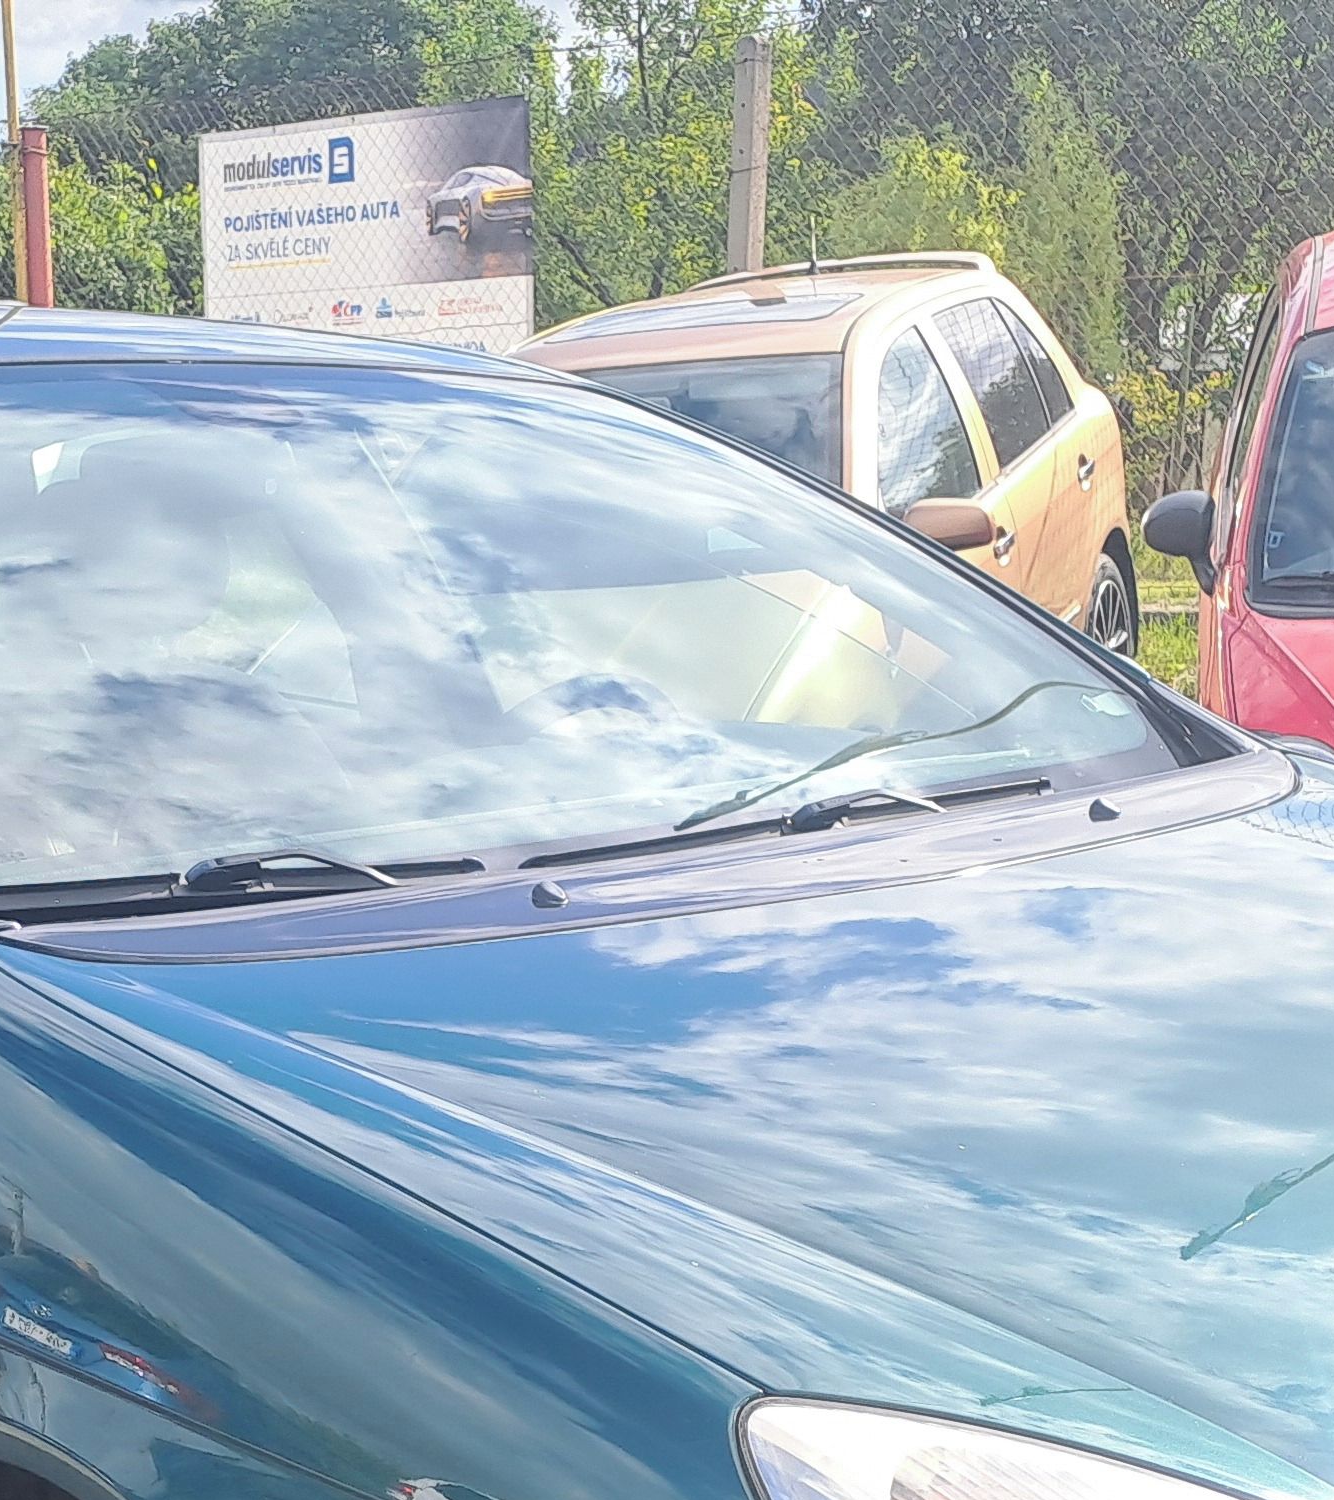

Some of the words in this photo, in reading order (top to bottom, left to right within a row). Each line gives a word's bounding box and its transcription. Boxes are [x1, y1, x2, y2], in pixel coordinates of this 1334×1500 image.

[223, 147, 323, 184] modulservis
[224, 205, 293, 233] POJIŠTĚNÍ
[295, 202, 356, 227] VAŠEHO
[360, 200, 401, 222] AUTA
[227, 244, 241, 261] ZA
[245, 236, 289, 261] SKVĚLÉ
[292, 236, 331, 256] CENY
